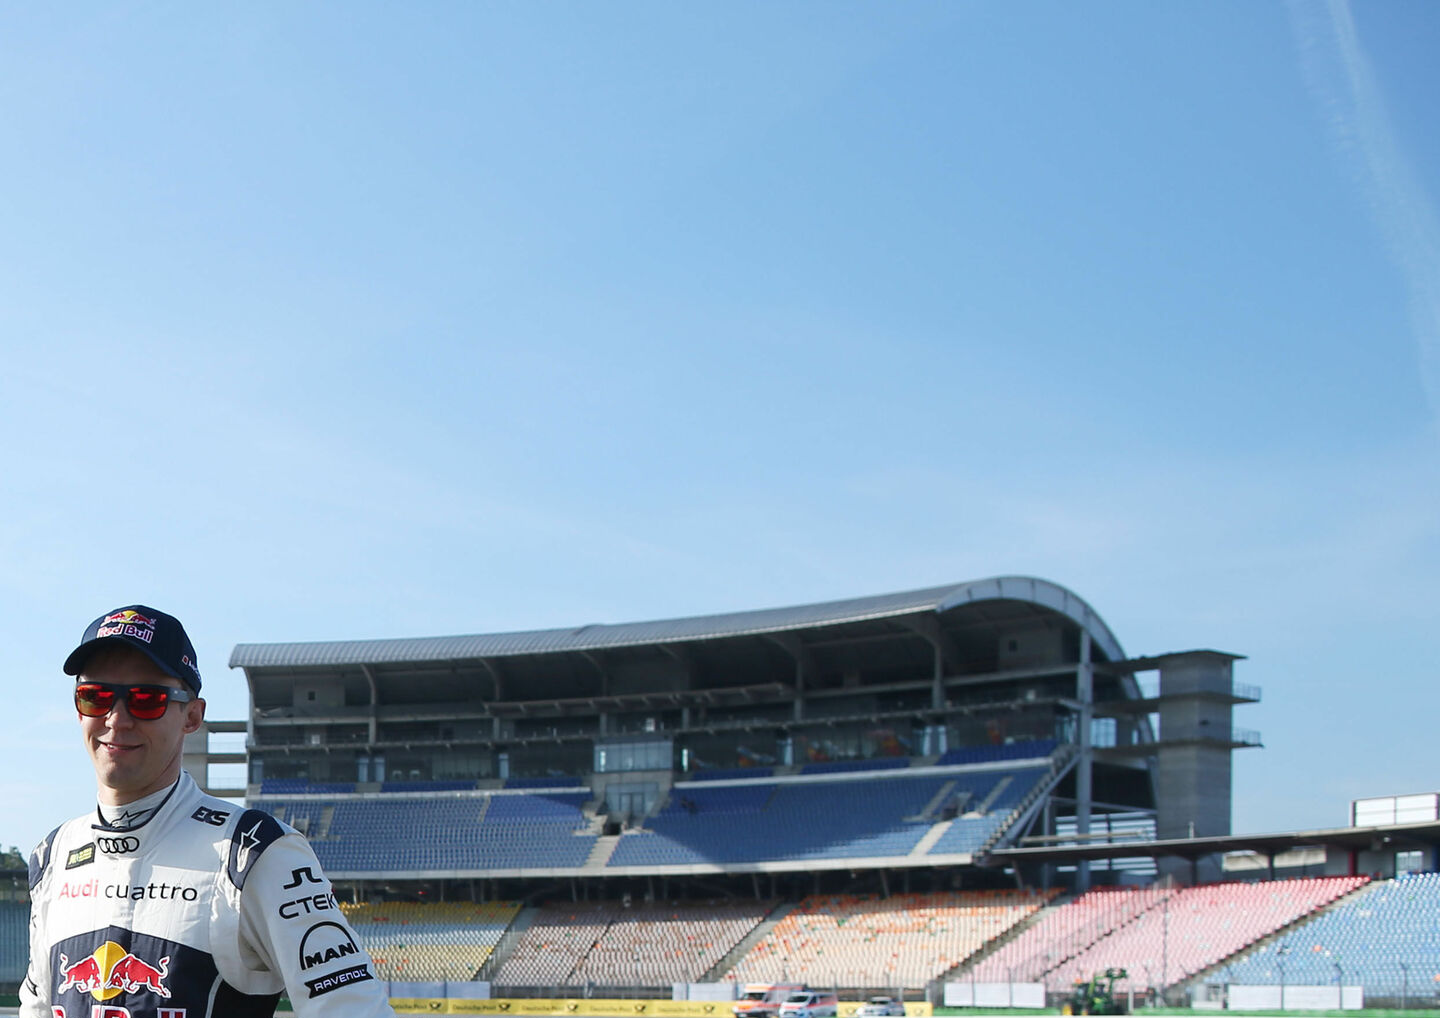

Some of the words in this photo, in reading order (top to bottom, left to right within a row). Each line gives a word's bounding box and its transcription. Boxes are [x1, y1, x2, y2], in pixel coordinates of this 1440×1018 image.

[97, 624, 124, 638] Red
[124, 625, 154, 643] Bull
[191, 806, 230, 826] EKS
[59, 879, 99, 899] Audi
[279, 893, 336, 919] CTEK
[305, 943, 355, 969] MAN
[314, 969, 366, 992] RAVENOL
